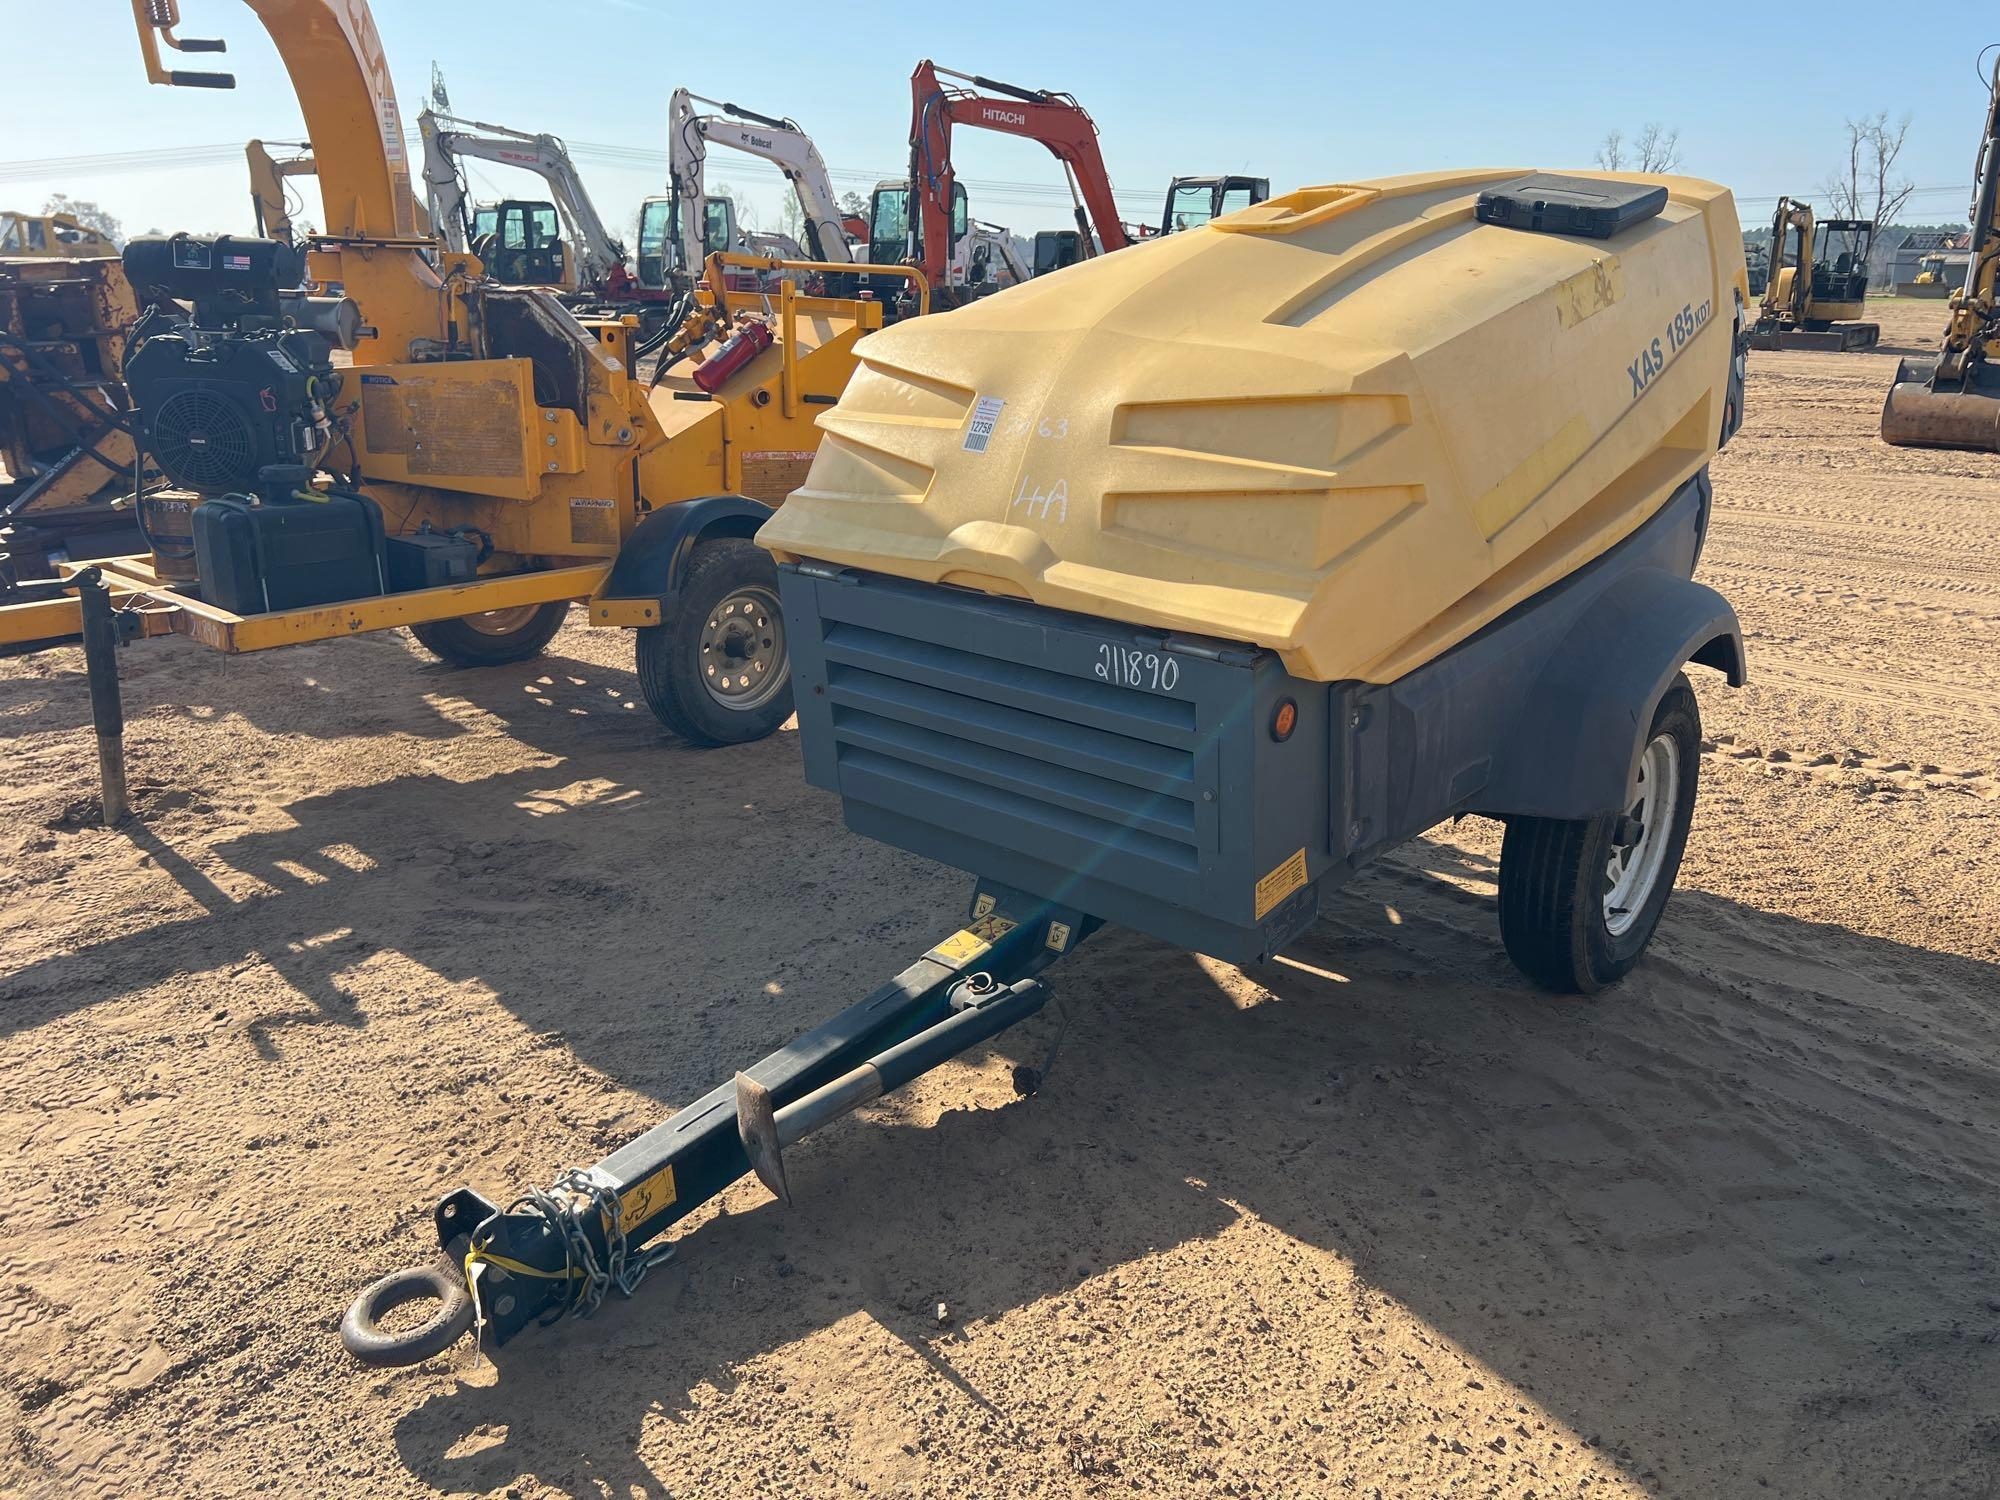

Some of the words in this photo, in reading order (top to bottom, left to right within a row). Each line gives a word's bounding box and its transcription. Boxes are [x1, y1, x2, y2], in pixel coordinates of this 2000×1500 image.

[982, 107, 1025, 125] HITACHI
[750, 135, 772, 149] Bobcat
[1627, 336, 1664, 399] XAS
[1666, 303, 1694, 354] 185
[1694, 298, 1711, 328] KD7
[970, 420, 993, 434] 12758
[1013, 475, 1068, 524] 4A
[1095, 644, 1179, 690] 211890
